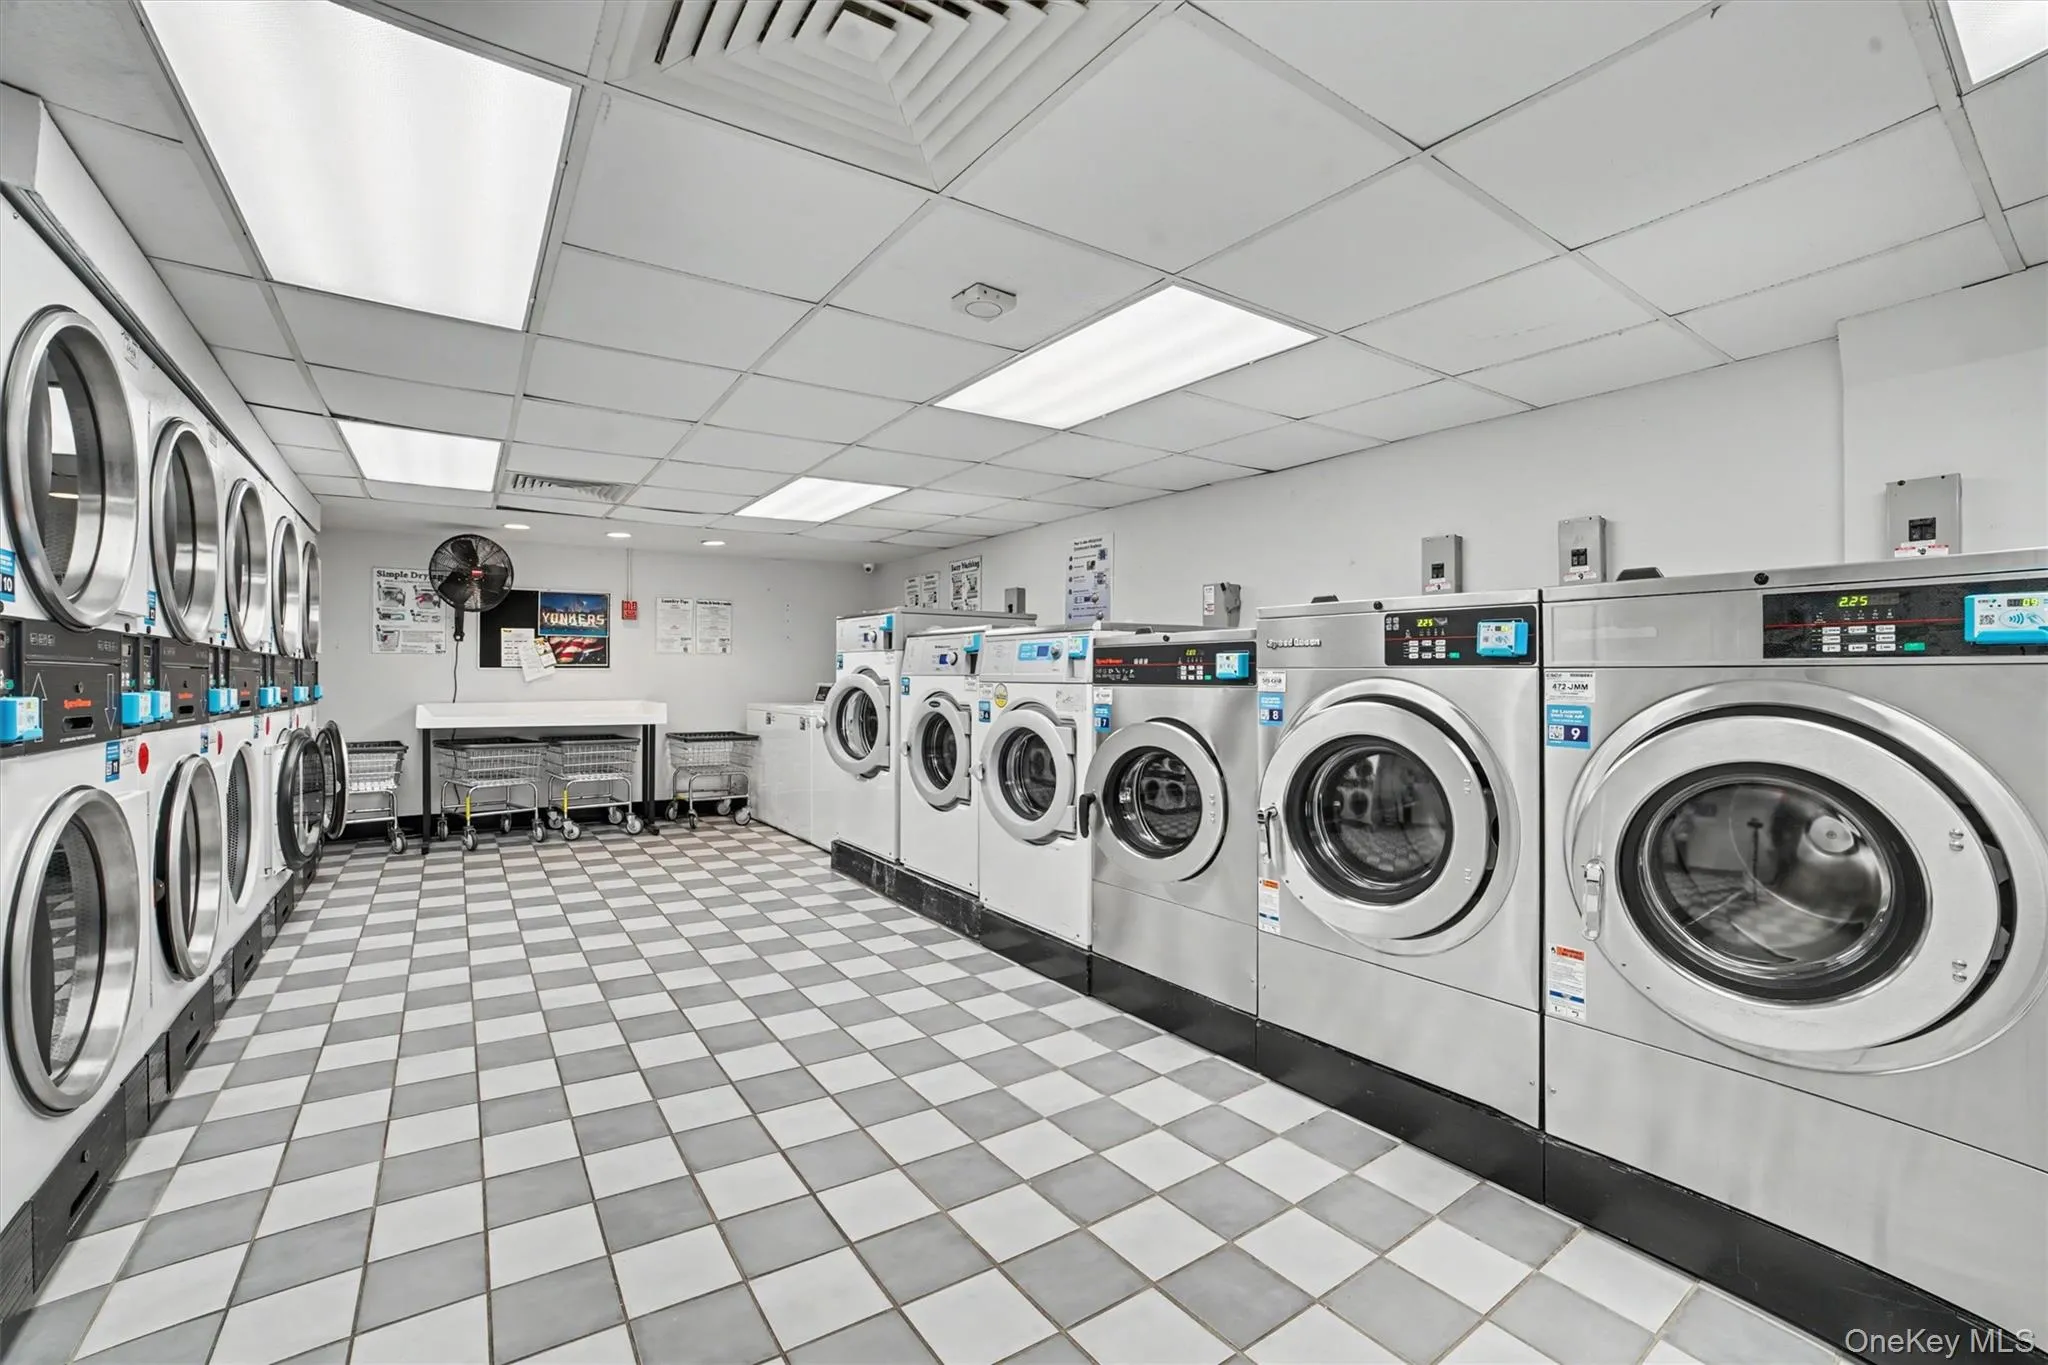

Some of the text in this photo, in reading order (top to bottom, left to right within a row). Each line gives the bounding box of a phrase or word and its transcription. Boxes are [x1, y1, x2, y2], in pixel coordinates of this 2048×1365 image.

[376, 570, 408, 580] Simple
[3, 577, 13, 592] 10
[542, 612, 605, 625] YONKERS
[1552, 683, 1589, 691] 472-JMM
[1272, 710, 1279, 720] 8
[1571, 727, 1581, 740] 9
